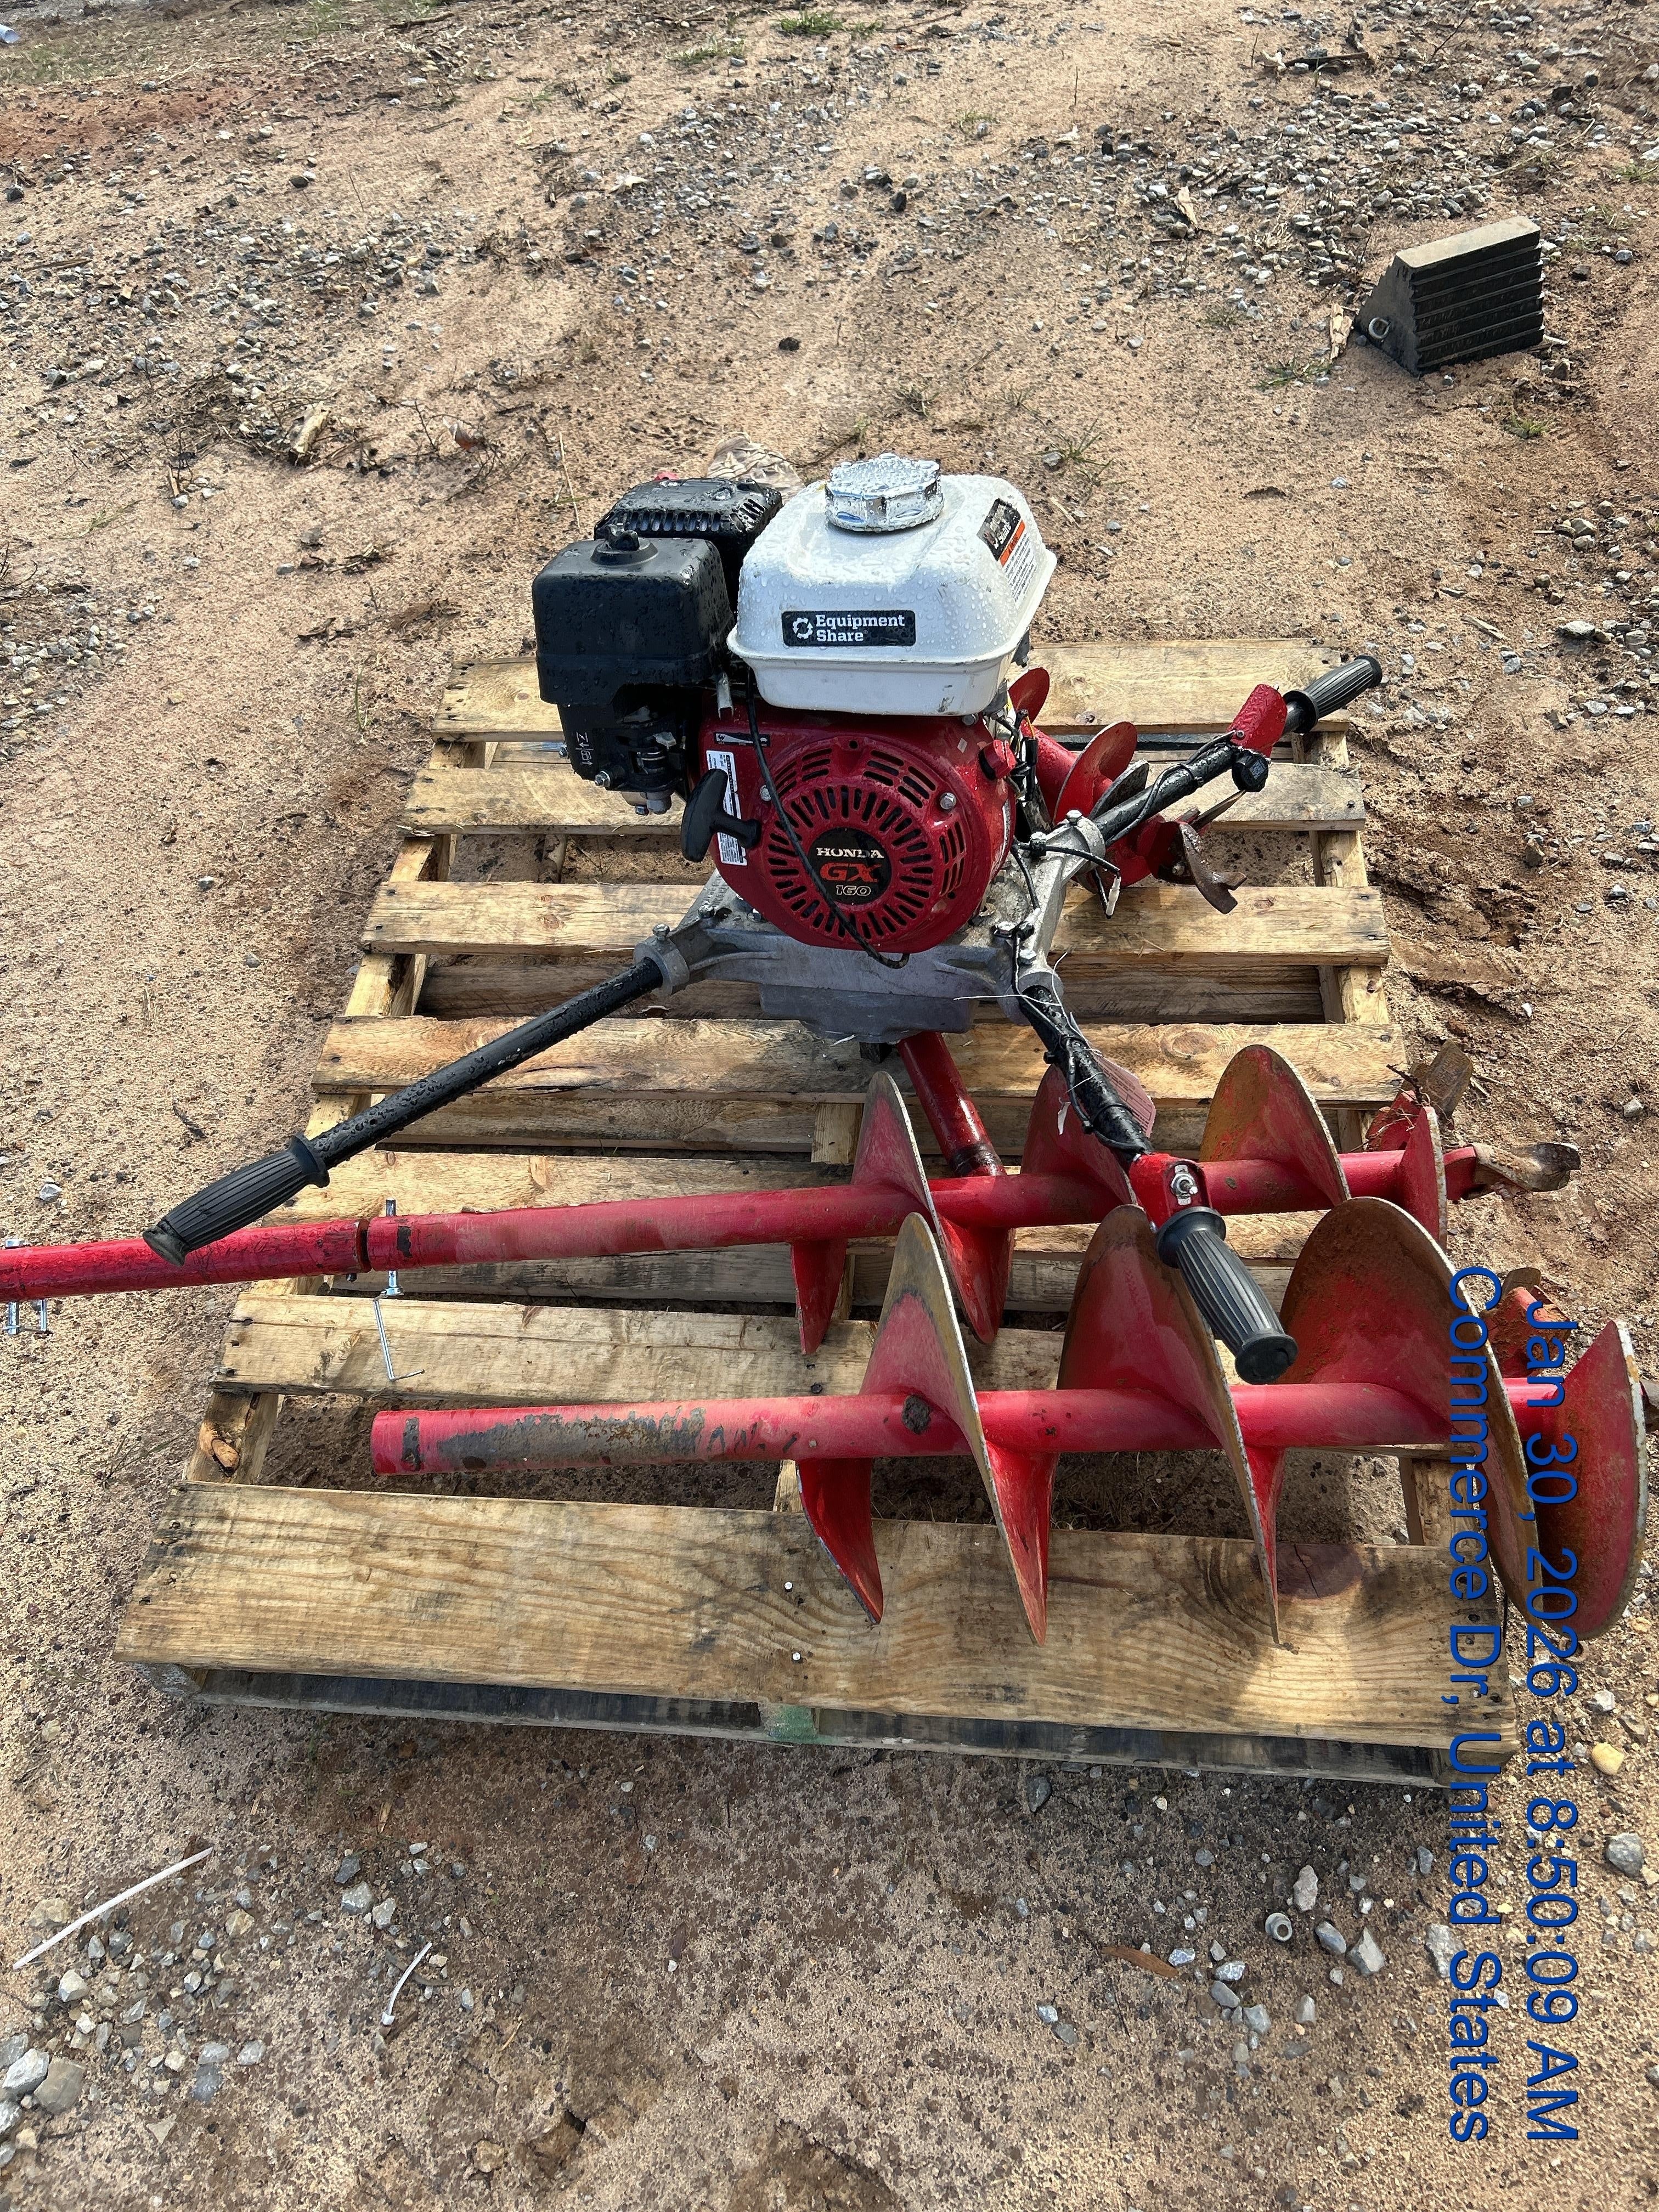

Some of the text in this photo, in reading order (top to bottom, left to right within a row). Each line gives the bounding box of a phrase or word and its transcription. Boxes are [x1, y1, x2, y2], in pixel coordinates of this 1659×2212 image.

[815, 614, 905, 630] Equipment
[816, 629, 864, 642] Share
[816, 847, 884, 859] HONDA
[820, 862, 882, 883] GX
[836, 884, 871, 897] 160
